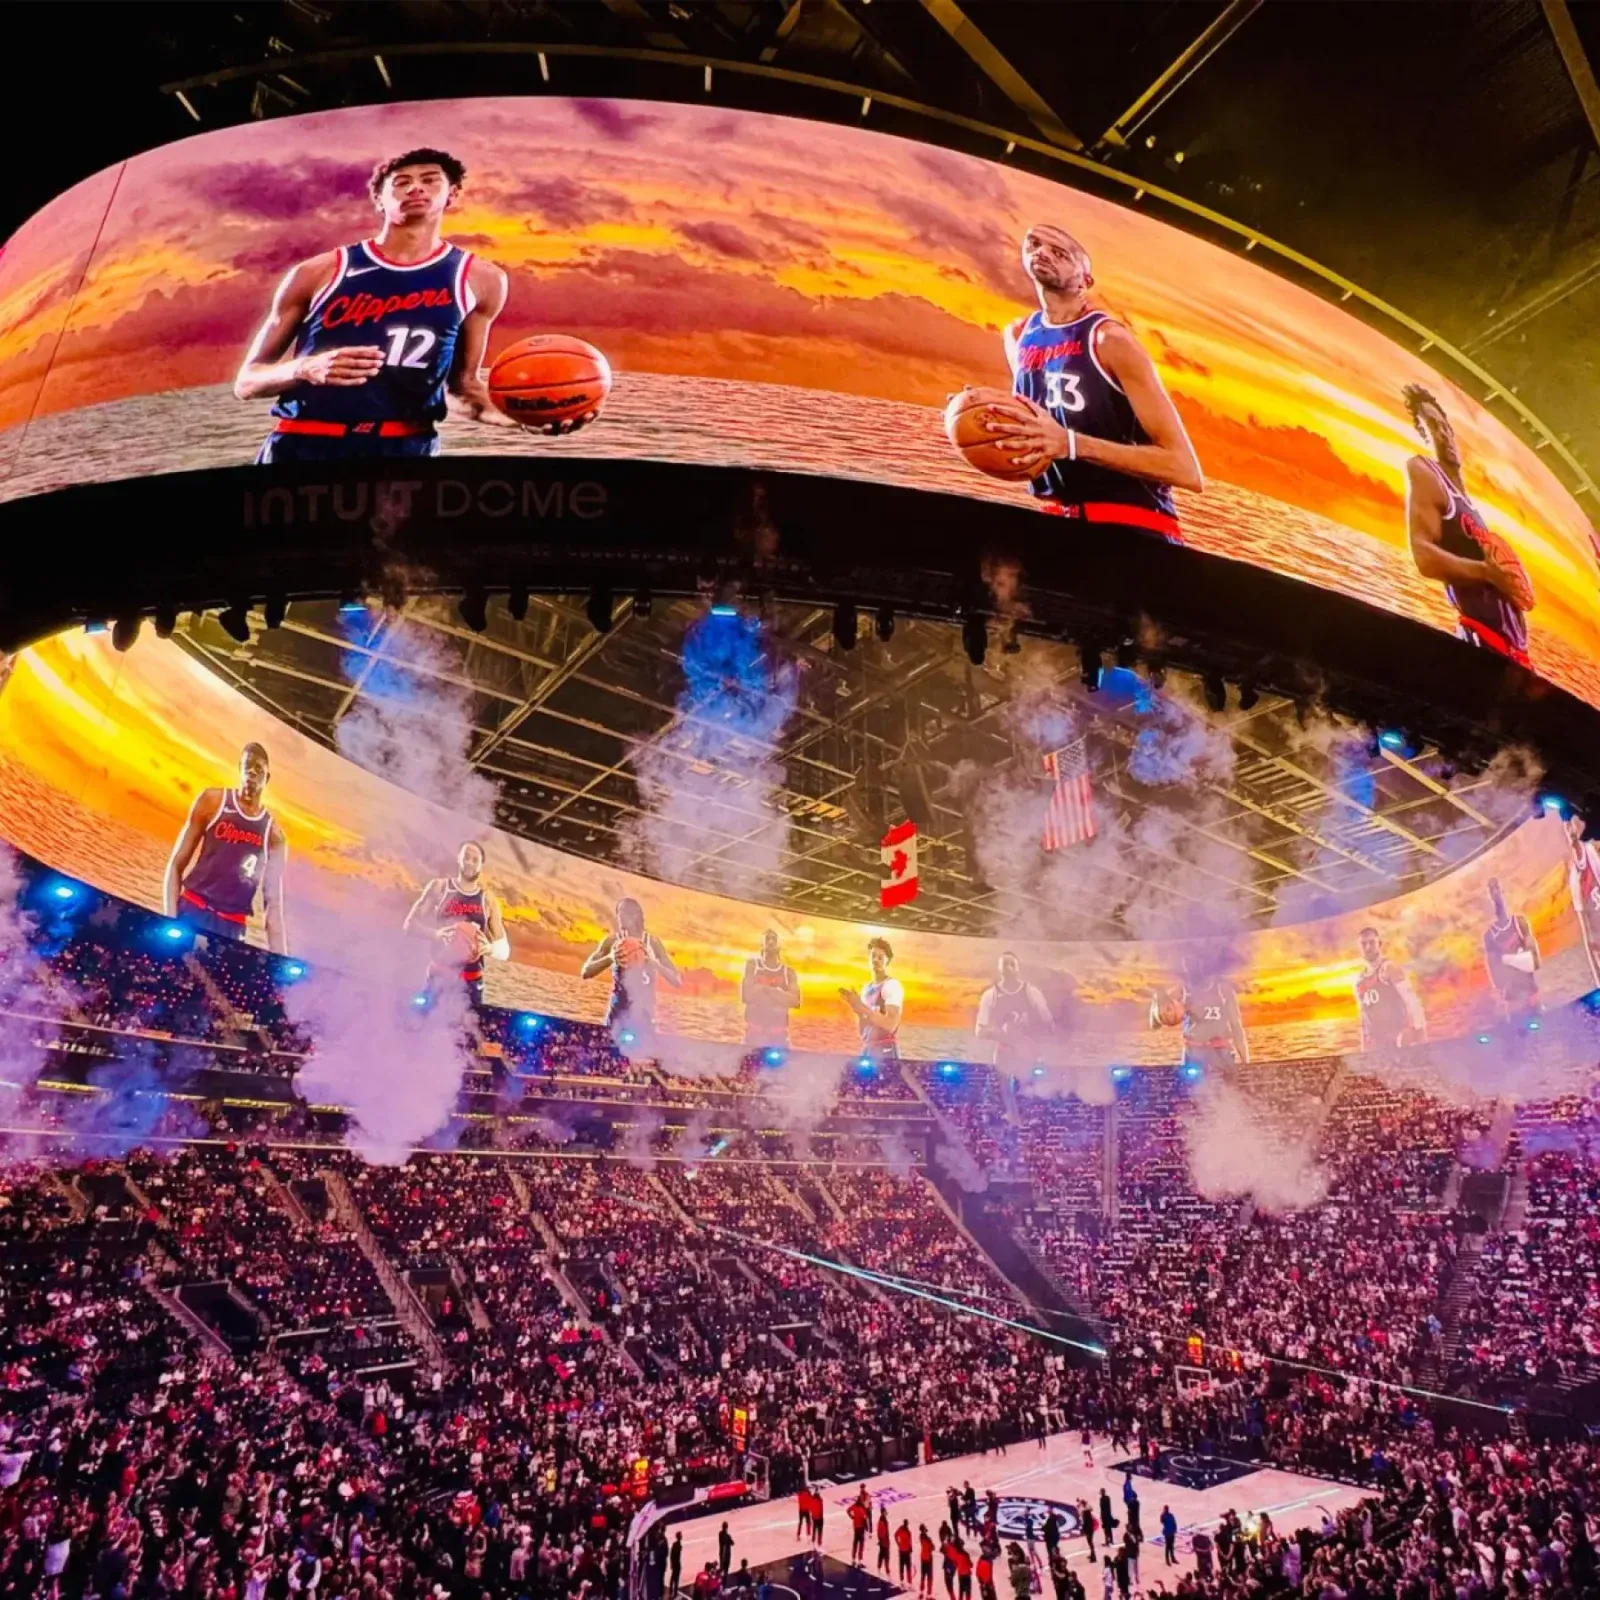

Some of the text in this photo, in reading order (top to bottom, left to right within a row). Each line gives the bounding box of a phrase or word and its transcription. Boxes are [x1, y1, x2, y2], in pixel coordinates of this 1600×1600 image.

[322, 287, 453, 328] Clippers
[386, 326, 436, 369] 12
[1045, 371, 1086, 412] 33
[215, 821, 263, 847] Clippers
[242, 854, 258, 877] 4
[1363, 989, 1380, 1007] 40
[1203, 1006, 1221, 1020] 23
